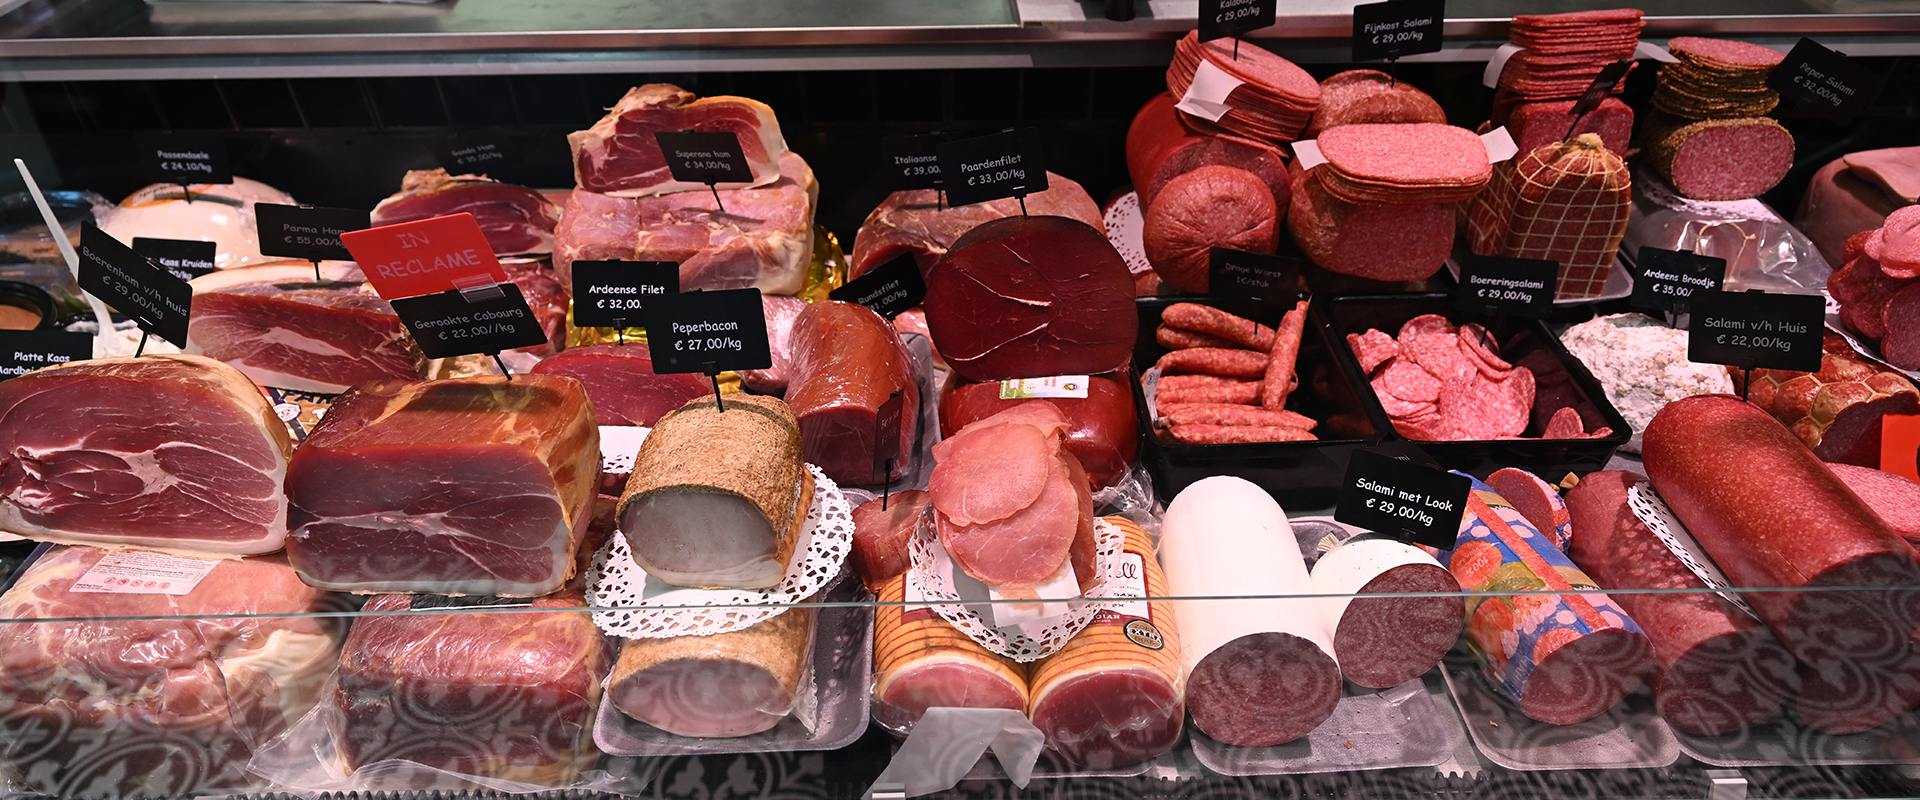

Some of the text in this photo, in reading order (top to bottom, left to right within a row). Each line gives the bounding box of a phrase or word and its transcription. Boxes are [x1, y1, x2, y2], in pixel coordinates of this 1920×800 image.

[1220, 0, 1257, 9] Kalabasj
[1216, 14, 1222, 23] €
[1364, 16, 1433, 34] Fijnkost Salami
[1372, 31, 1423, 44] € 29,00/kg
[1800, 62, 1857, 96] Peper Salami
[713, 150, 731, 158] ham
[894, 155, 937, 164] Italiaanse
[161, 162, 168, 170] €
[684, 161, 691, 169] €
[904, 165, 941, 176] € 39,00
[961, 154, 1022, 173] Paardenfilet
[967, 169, 1025, 186] € 33,00/kg
[283, 223, 346, 235] Parma Ham
[284, 235, 292, 243] €
[396, 231, 430, 249] IN
[181, 259, 213, 268] Kruiden
[376, 249, 482, 280] RECLAME
[1225, 263, 1281, 278] Droge Worst
[82, 246, 187, 317] Boerenham v/h huis
[168, 270, 193, 281] 0/kg
[1470, 275, 1544, 289] Boereringsalami
[1643, 269, 1715, 289] Ardeens Broodje
[589, 284, 665, 294] Ardeense Filet
[858, 279, 899, 305] Rundsfilet
[1477, 289, 1533, 304] € 29,00/kg
[1652, 283, 1694, 297] € 35,00/
[102, 275, 164, 320] € 29,00/kg
[596, 299, 642, 310] € 32,00
[414, 308, 523, 330] Gerookte Cobourg
[1704, 317, 1807, 334] Salami v/h Huis
[438, 323, 515, 341] € 22,00//kg
[672, 320, 738, 336] Peperbacon
[674, 337, 742, 351] € 27,00/kg
[1716, 334, 1791, 352] € 22,00/kg
[14, 352, 70, 362] Platte Kaas
[1356, 478, 1453, 512] Salami met Look
[1366, 498, 1434, 527] € 29,00/kg
